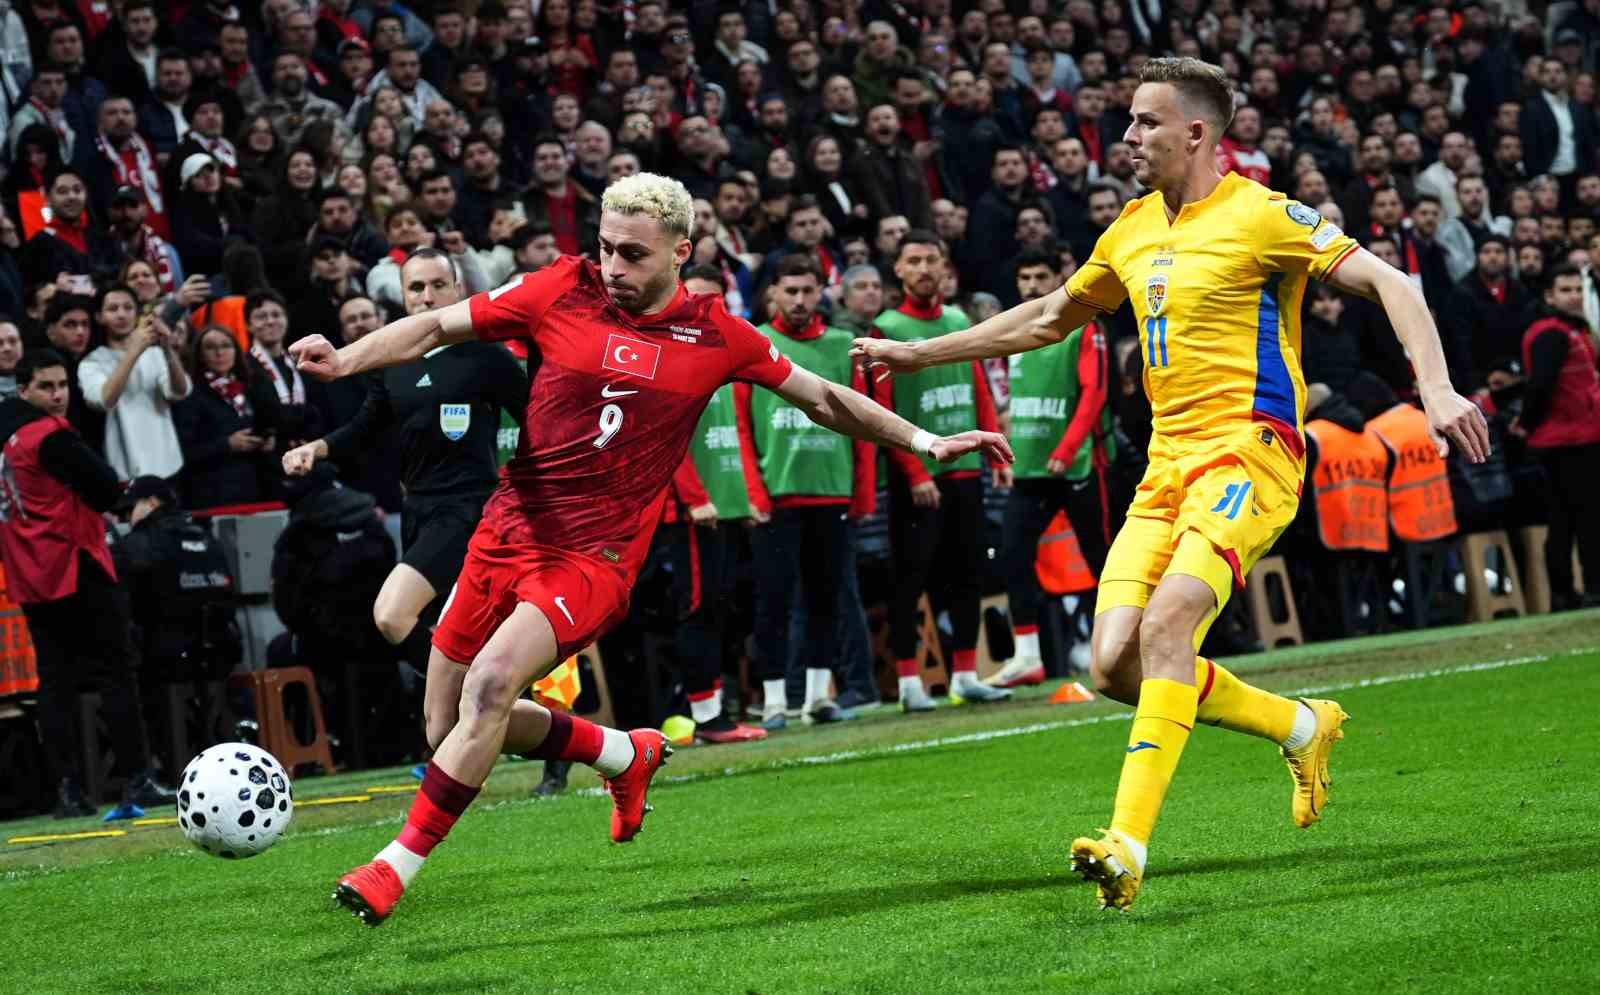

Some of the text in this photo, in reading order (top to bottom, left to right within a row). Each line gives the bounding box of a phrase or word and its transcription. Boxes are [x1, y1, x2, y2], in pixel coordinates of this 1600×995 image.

[1146, 317, 1168, 367] 11
[443, 407, 466, 416] FIFA
[592, 403, 624, 449] 9
[1210, 480, 1252, 520] 11
